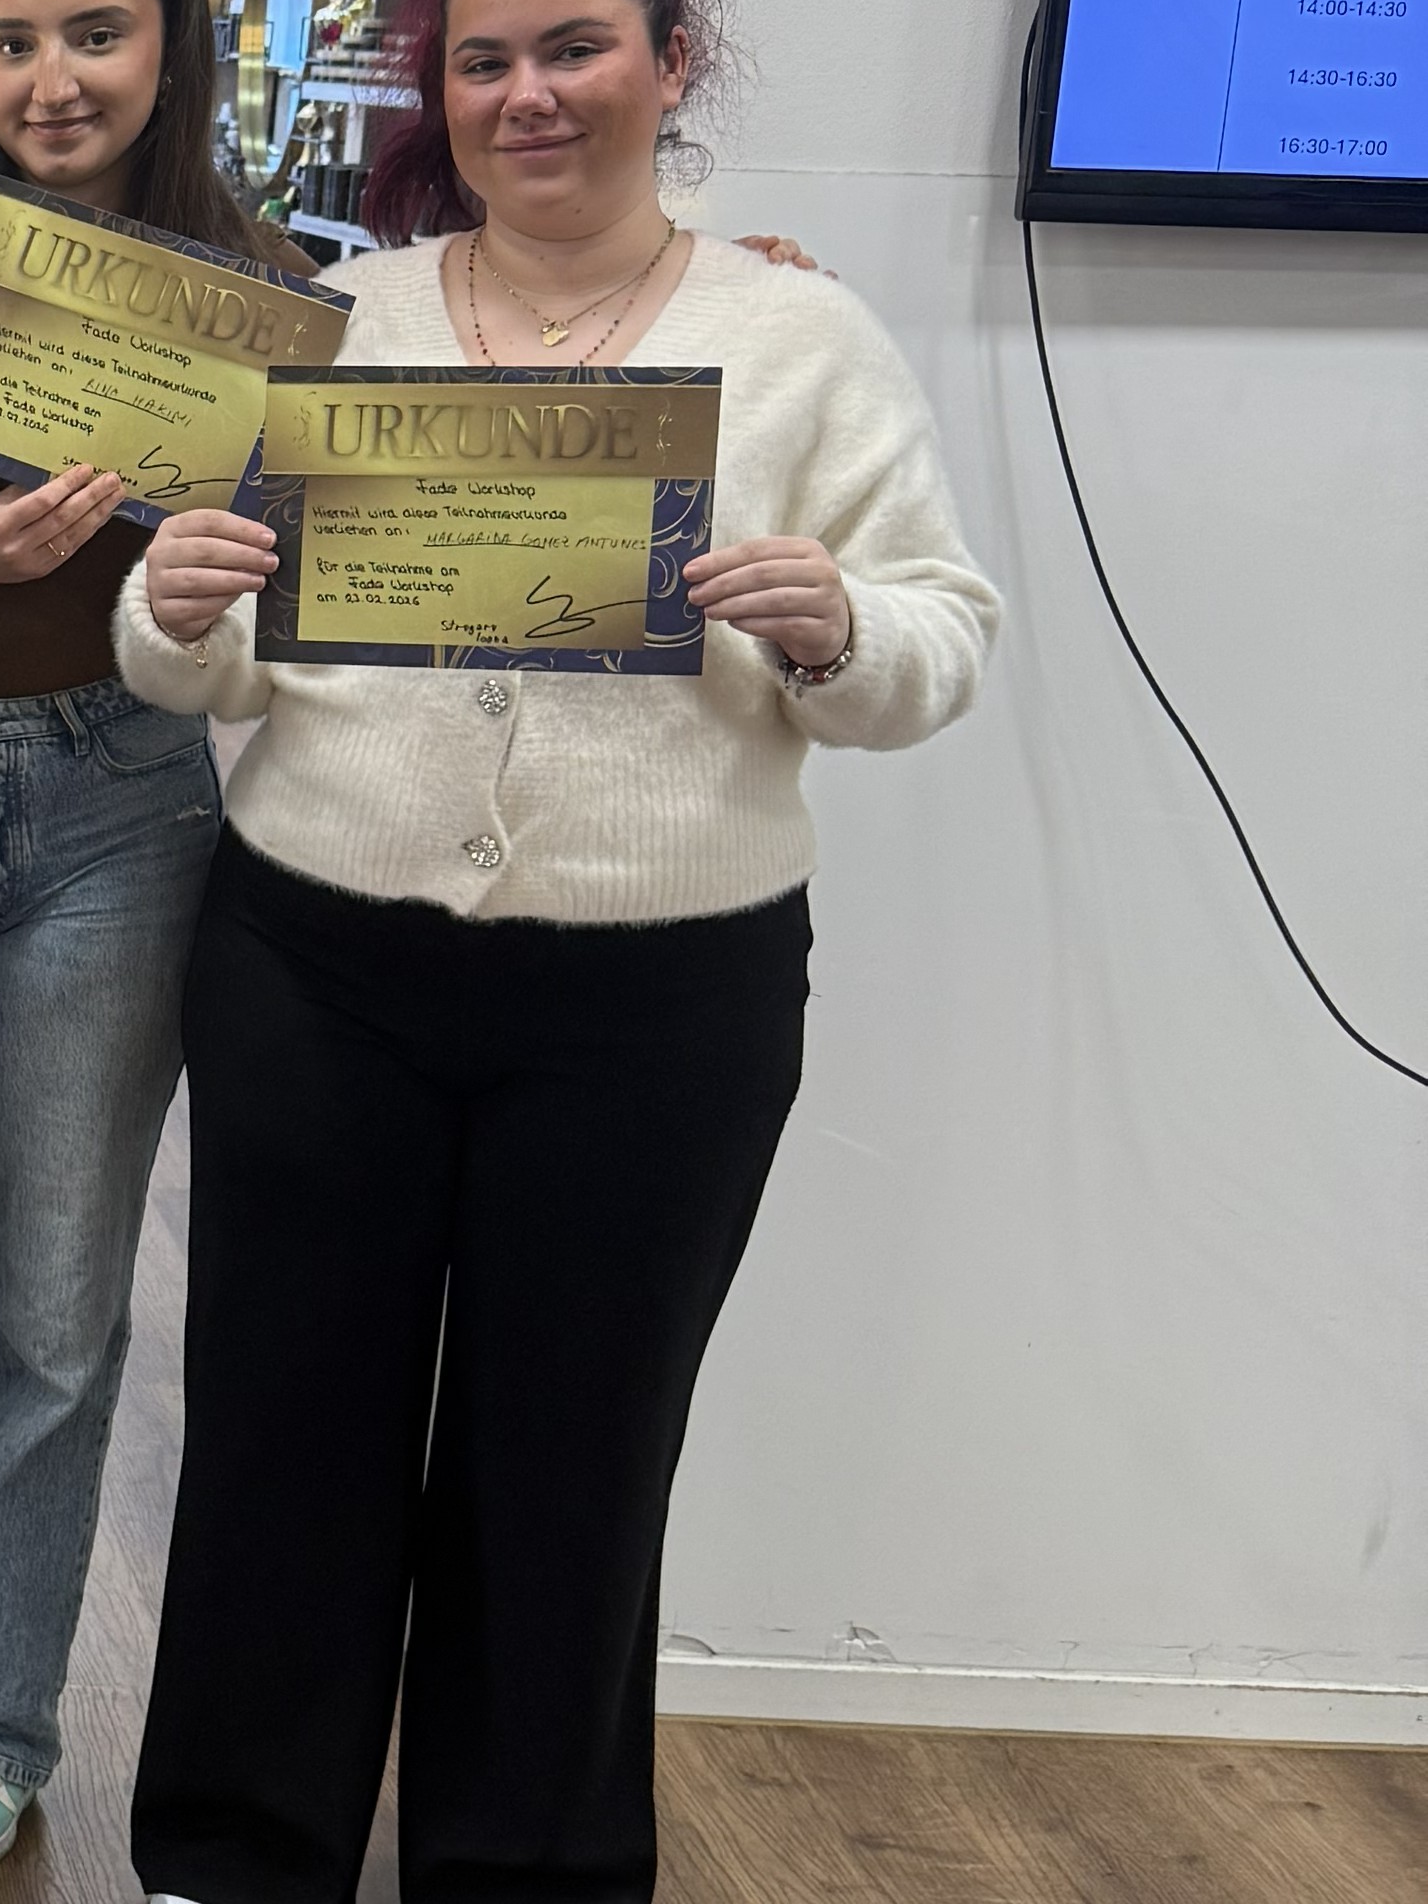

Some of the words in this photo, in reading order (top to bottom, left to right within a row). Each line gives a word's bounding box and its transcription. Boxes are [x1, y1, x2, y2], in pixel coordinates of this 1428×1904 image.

[1298, 0, 1407, 17] 14:00-14:30
[1288, 69, 1397, 87] 14:30-16:30
[1280, 137, 1388, 156] 16:30-17:00
[17, 225, 281, 356] URKUNDE
[82, 315, 120, 344] Fade
[130, 335, 191, 369] Workshop
[84, 406, 102, 418] am
[324, 404, 638, 459] URKUNDE
[416, 479, 458, 496] Fade
[469, 482, 536, 500] Workshop
[440, 566, 460, 577] am
[317, 594, 337, 603] am
